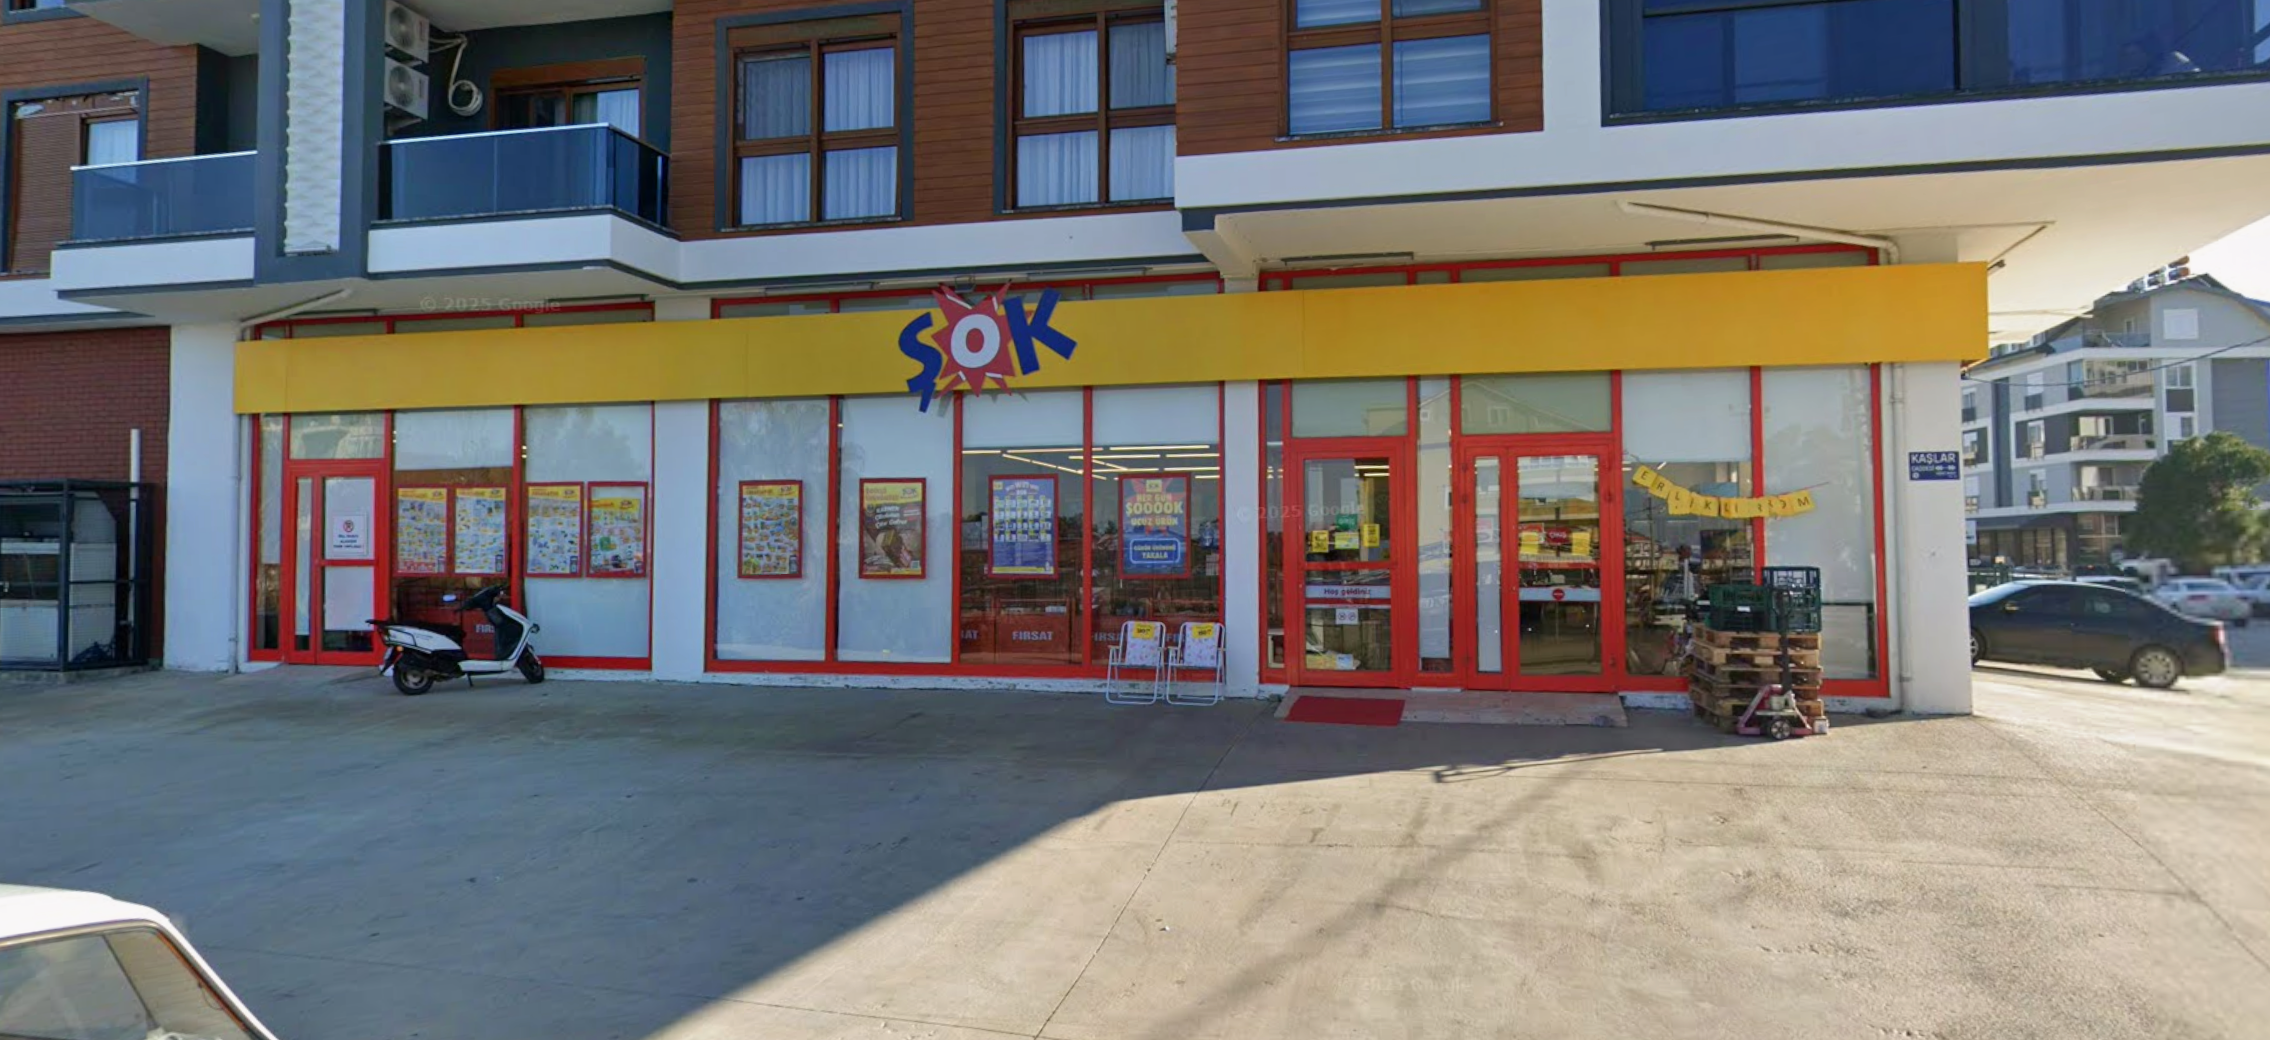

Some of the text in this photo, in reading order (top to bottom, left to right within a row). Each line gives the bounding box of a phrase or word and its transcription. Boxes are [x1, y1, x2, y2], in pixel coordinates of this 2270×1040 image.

[898, 286, 1077, 413] ŞOK
[1911, 453, 1956, 464] KAŞLAR
[1324, 588, 1339, 597] Hoş
[1012, 630, 1054, 640] FIRSAT
